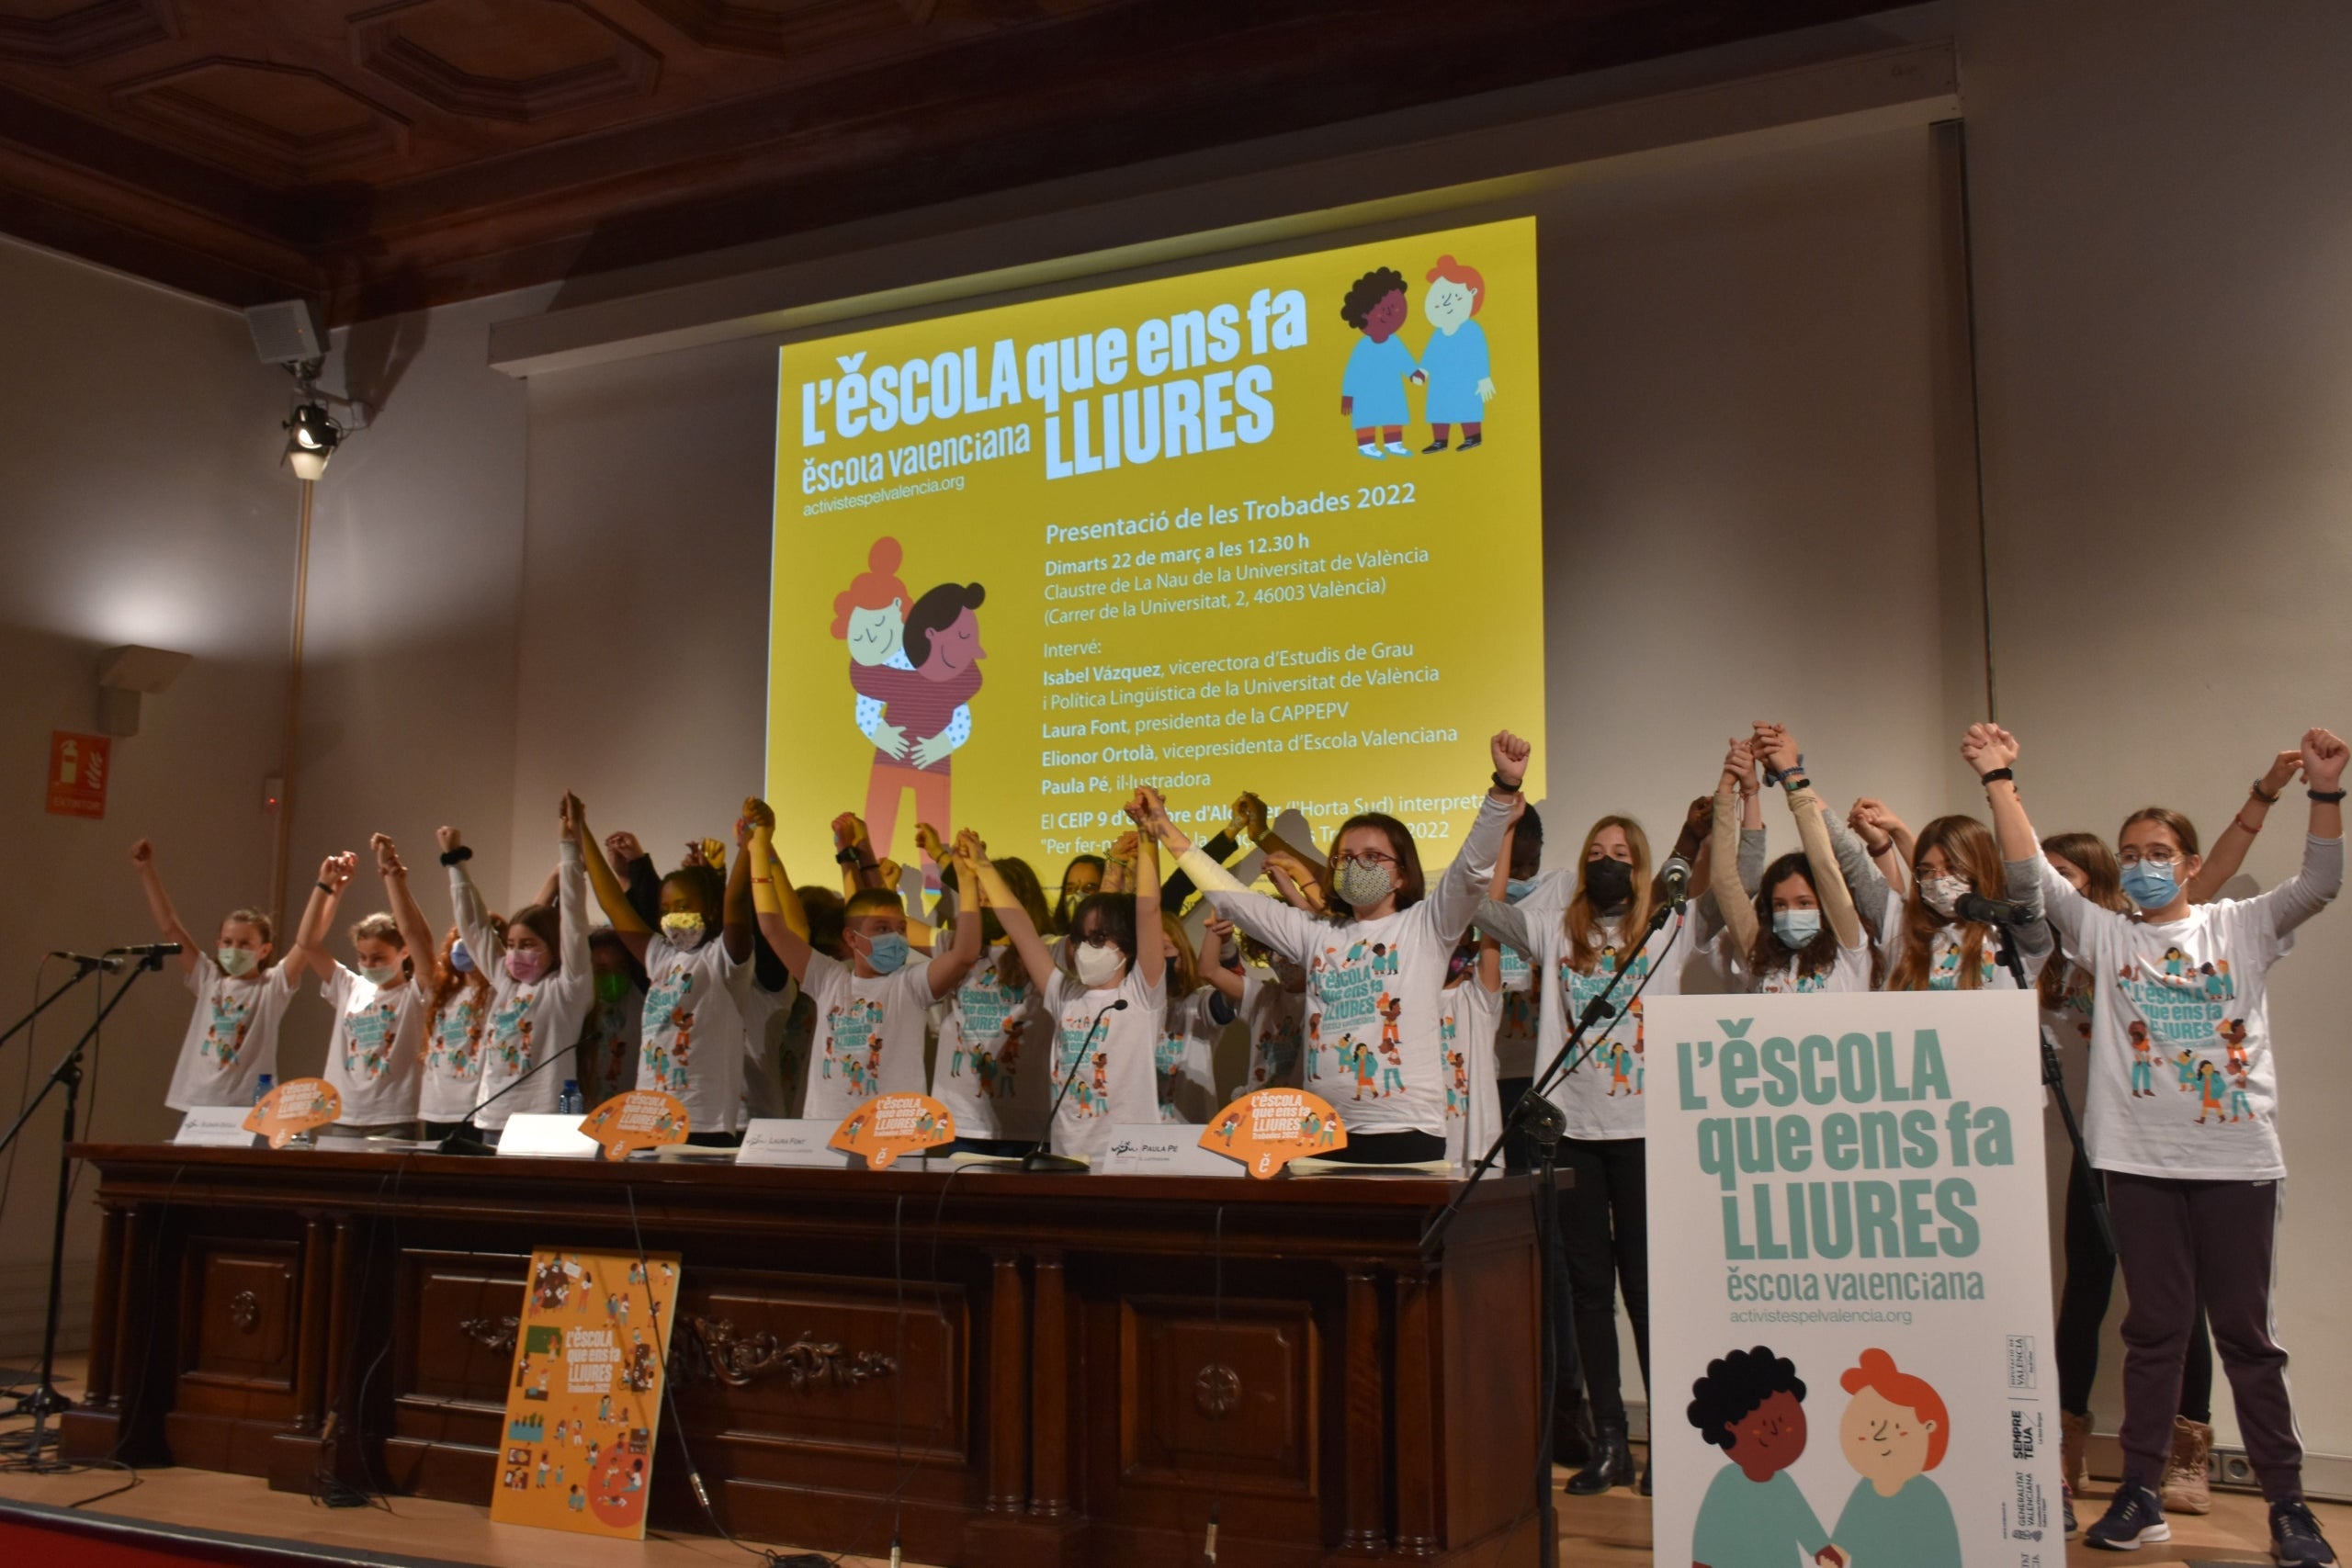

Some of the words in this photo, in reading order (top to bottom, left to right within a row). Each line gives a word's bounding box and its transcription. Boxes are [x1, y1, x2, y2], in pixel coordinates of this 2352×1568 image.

[1026, 327, 1128, 413] que
[1136, 303, 1240, 377] ens
[1247, 288, 1307, 355] fa
[1046, 365, 1274, 480] LLIURES
[888, 423, 1030, 477] valenciana
[803, 476, 965, 516] activistespelvalencia.org
[1046, 510, 1170, 545] Presentació
[1174, 507, 1203, 530] de
[1208, 502, 1238, 525] les
[1243, 491, 1351, 521] Trobades
[1357, 481, 1416, 509] 2022
[1044, 582, 1107, 601] Claustre
[1110, 578, 1130, 593] de
[1134, 576, 1152, 592] La
[1156, 573, 1188, 589] Nau
[1193, 569, 1213, 585] de
[1217, 567, 1231, 582] la
[1236, 558, 1326, 581] Universitat
[1330, 554, 1352, 571] de
[1356, 547, 1430, 569] València
[1045, 557, 1108, 577] Dimarts
[1111, 553, 1131, 570] 22
[1135, 550, 1156, 567] de
[1159, 548, 1201, 564] març
[1204, 547, 1215, 559] a
[1219, 541, 1242, 557] les
[1247, 534, 1294, 554] 12.30
[1298, 532, 1309, 549] h
[1044, 608, 1095, 626] (Carrer
[1099, 604, 1119, 620] de
[1123, 602, 1136, 617] la
[1140, 592, 1231, 615] Universitat,
[1236, 591, 1250, 607] 2,
[1254, 585, 1305, 604] 46003
[1308, 577, 1386, 599] València)
[1043, 667, 1090, 686] Isabel
[1092, 663, 1165, 682] Vázquez,
[1169, 656, 1260, 675] vicerectora
[1344, 644, 1367, 661] de
[1371, 642, 1414, 660] Grau
[1044, 638, 1102, 658] Intervé:
[1043, 695, 1047, 710] i
[1051, 693, 1106, 710] Política
[1110, 684, 1196, 708] Lingüística
[1200, 682, 1221, 698] de
[1225, 680, 1240, 696] la
[1244, 673, 1335, 695] Universitat
[1340, 671, 1363, 688] de
[1365, 666, 1440, 686] València
[1042, 722, 1087, 739] Laura
[1090, 718, 1130, 735] Font,
[1135, 713, 1221, 736] presidenta
[1225, 709, 1247, 726] de
[1250, 707, 1265, 724] la
[1269, 701, 1350, 723] CAPPEPV
[1042, 750, 1099, 767] Elionor
[1102, 744, 1159, 763] Ortolà,
[1162, 738, 1283, 761] vicepresidenta
[1361, 727, 1459, 748] Valenciana
[1041, 778, 1085, 795] Paula
[1089, 776, 1113, 794] Pé,
[1041, 813, 1054, 830] El
[1057, 811, 1094, 829] CEIP
[1097, 811, 1108, 827] 9
[1354, 796, 1395, 815] Sud)
[2172, 1005, 2203, 1021] ens
[2206, 1003, 2222, 1021] fa
[1251, 1108, 1274, 1121] que
[1275, 1107, 1298, 1117] ens
[1298, 1105, 1312, 1117] fa
[1697, 1113, 1813, 1191] que
[1821, 1109, 1939, 1171] ens
[1945, 1100, 2014, 1168] fa
[1721, 1177, 1981, 1260] LLIURES
[1824, 1271, 1985, 1301] valenciana
[1729, 1308, 1912, 1325] activistespelvalencia.org
[2011, 1410, 2023, 1460] SEMPRE
[2023, 1427, 2033, 1461] TEUA
[2016, 1472, 2026, 1527] GENERALITAT
[2025, 1472, 2034, 1526] VALENCIANA
